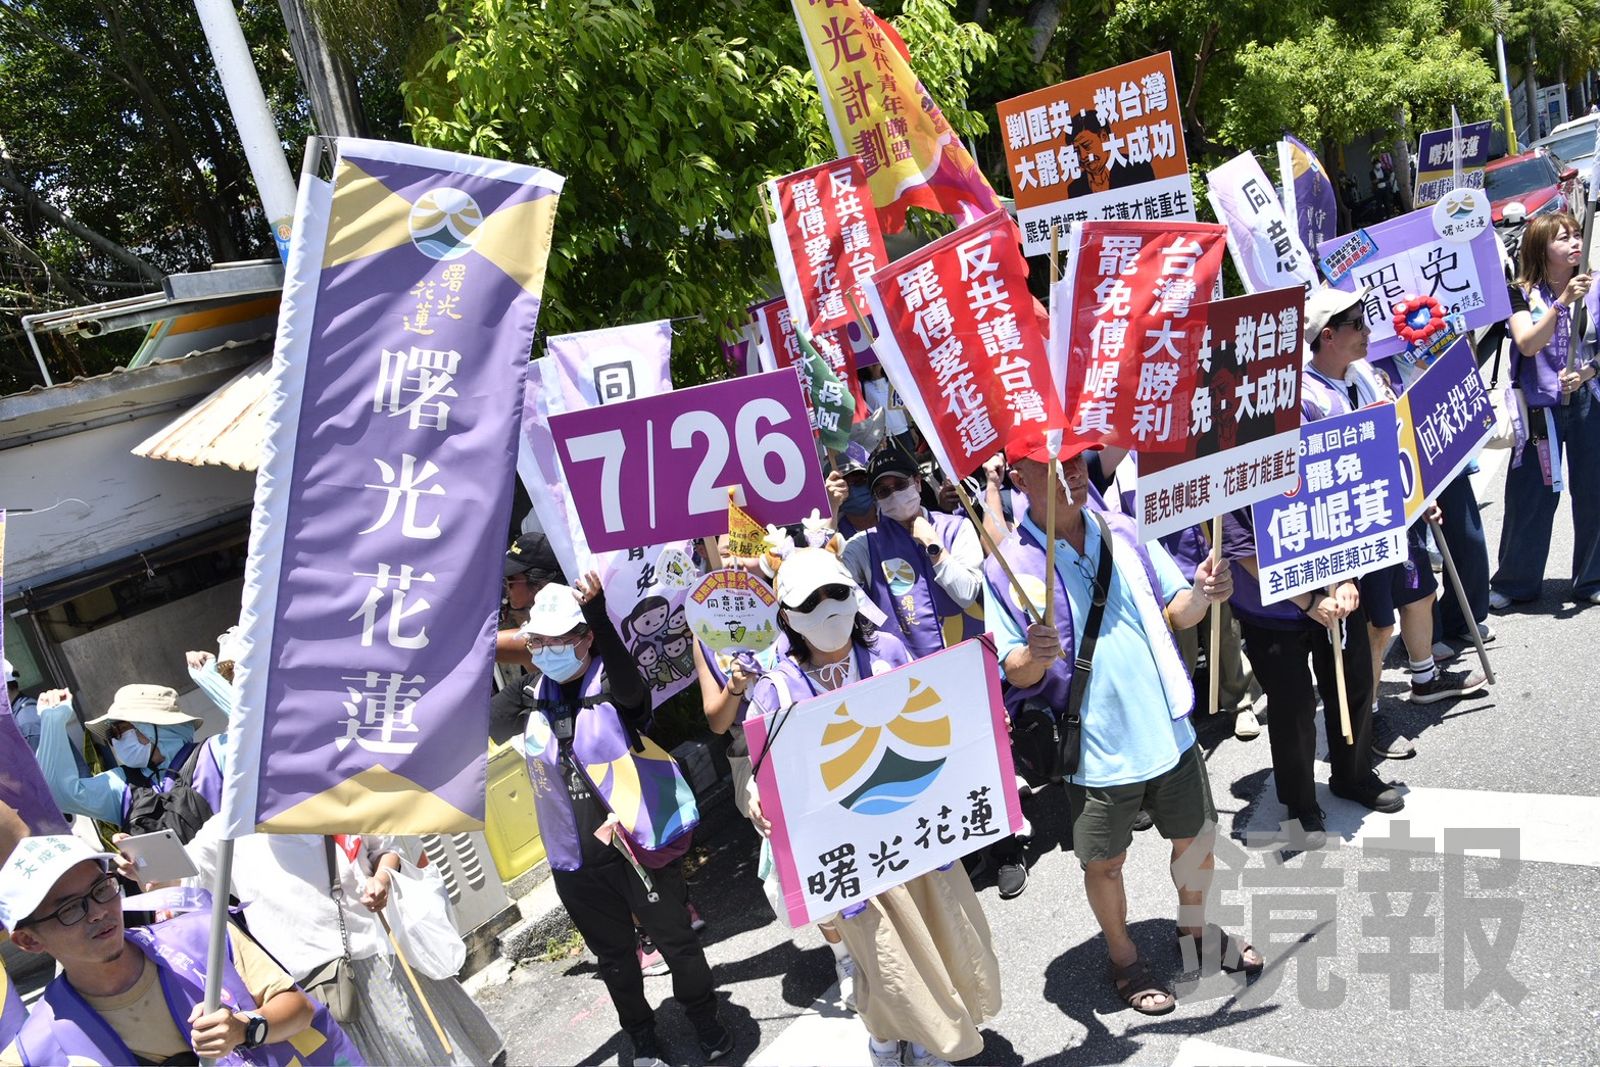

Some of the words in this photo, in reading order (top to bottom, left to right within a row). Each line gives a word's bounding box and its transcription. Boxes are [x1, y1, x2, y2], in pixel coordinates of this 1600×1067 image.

[808, 0, 891, 179] 光計劃
[860, 9, 912, 164] 新世代青年聯盟
[437, 264, 467, 320] 曙光
[791, 178, 848, 323] 罷傅愛花蓮
[897, 260, 1000, 458] 罷傅愛花蓮
[956, 233, 1048, 426] 反共護台灣
[1130, 236, 1204, 442] 台灣大勝利
[1305, 453, 1363, 491] 罷免
[1414, 366, 1489, 467] 回家投票
[335, 345, 462, 756] 曙光花蓮
[706, 595, 758, 612] 同意罷免
[807, 786, 1001, 903] 曙光花蓮
